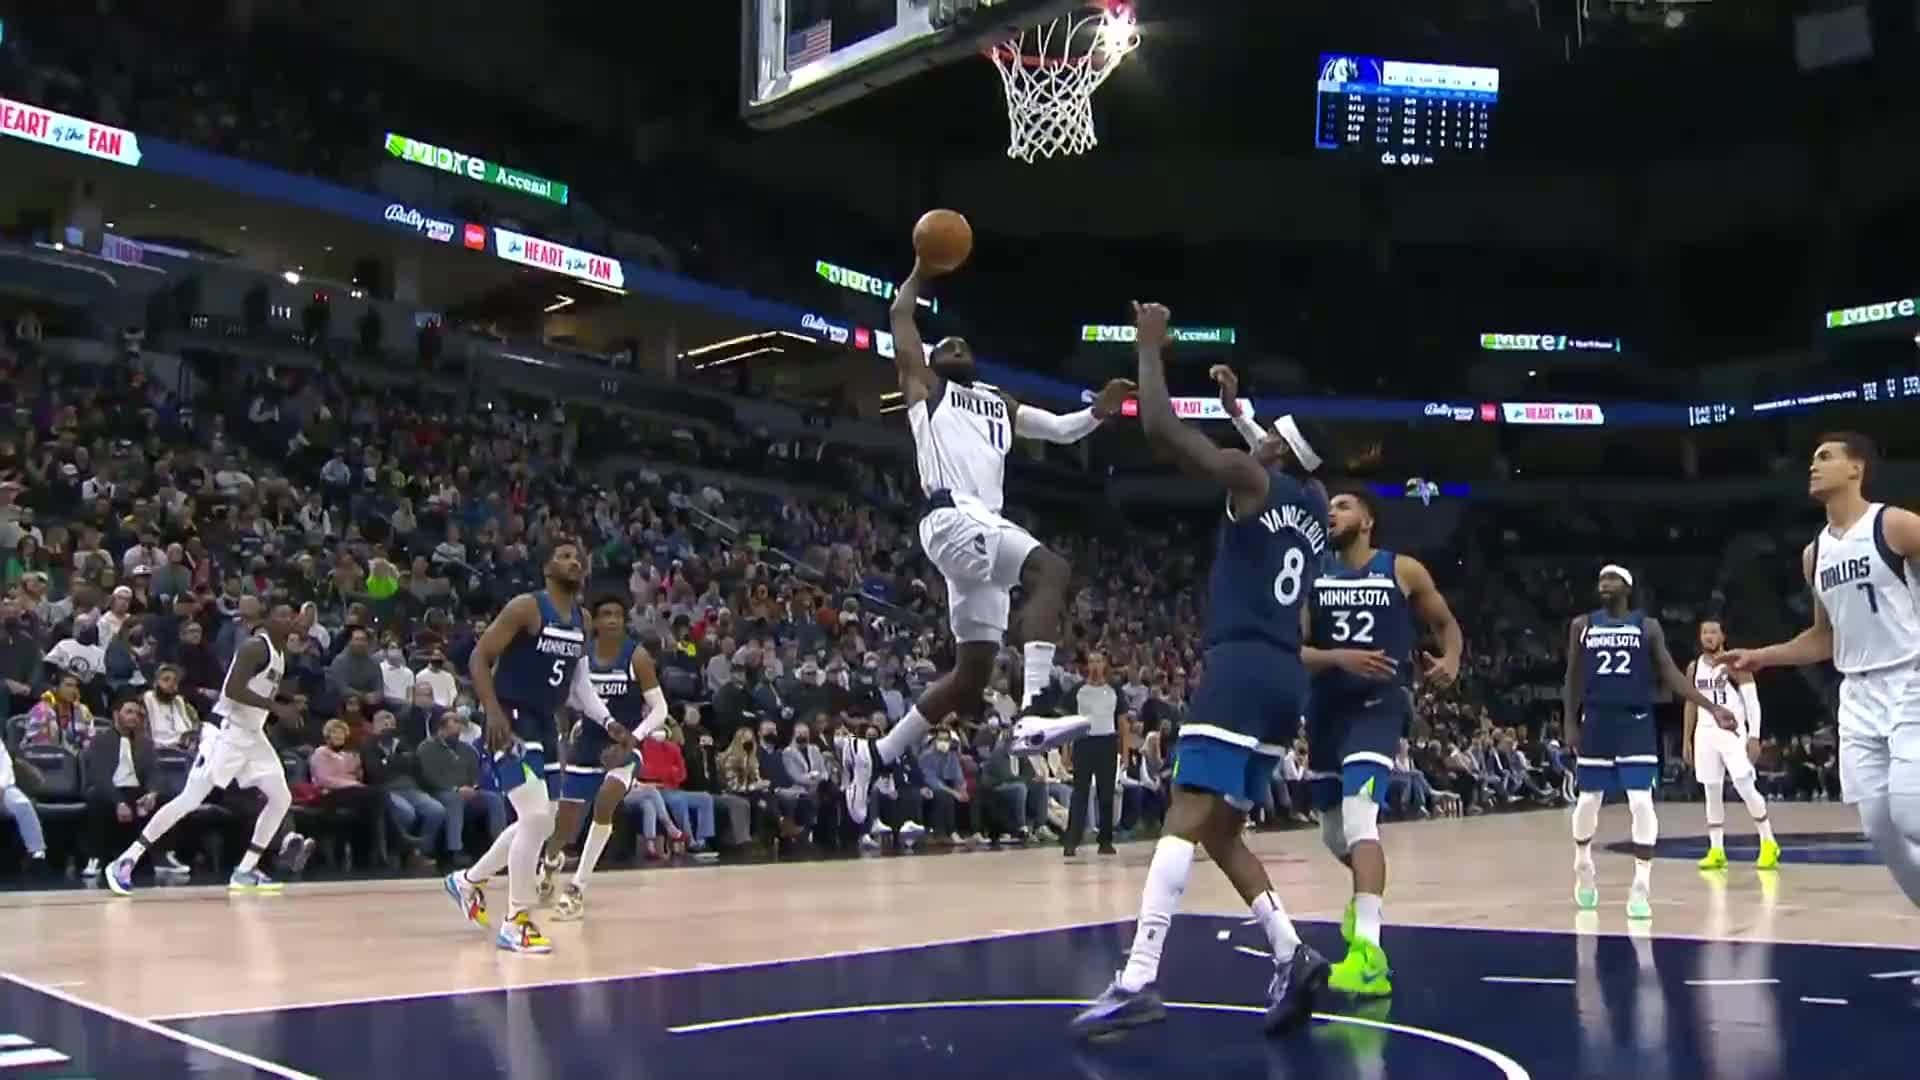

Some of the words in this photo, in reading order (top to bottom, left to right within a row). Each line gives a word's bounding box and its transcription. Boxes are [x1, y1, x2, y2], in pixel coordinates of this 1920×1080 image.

[88, 128, 122, 156] FAN
[525, 240, 565, 268] HEART
[588, 258, 612, 280] FAN
[987, 419, 1003, 449] 11
[1259, 504, 1328, 554] VANDERBILT
[1274, 547, 1304, 606] 8
[1820, 555, 1871, 592] DALLAS
[1319, 590, 1390, 607] MINNESOTA
[1857, 582, 1878, 613] 7
[1331, 610, 1375, 642] 32
[1586, 635, 1640, 649] MINNESOTA
[548, 660, 566, 686] 5
[1596, 651, 1631, 674] 22
